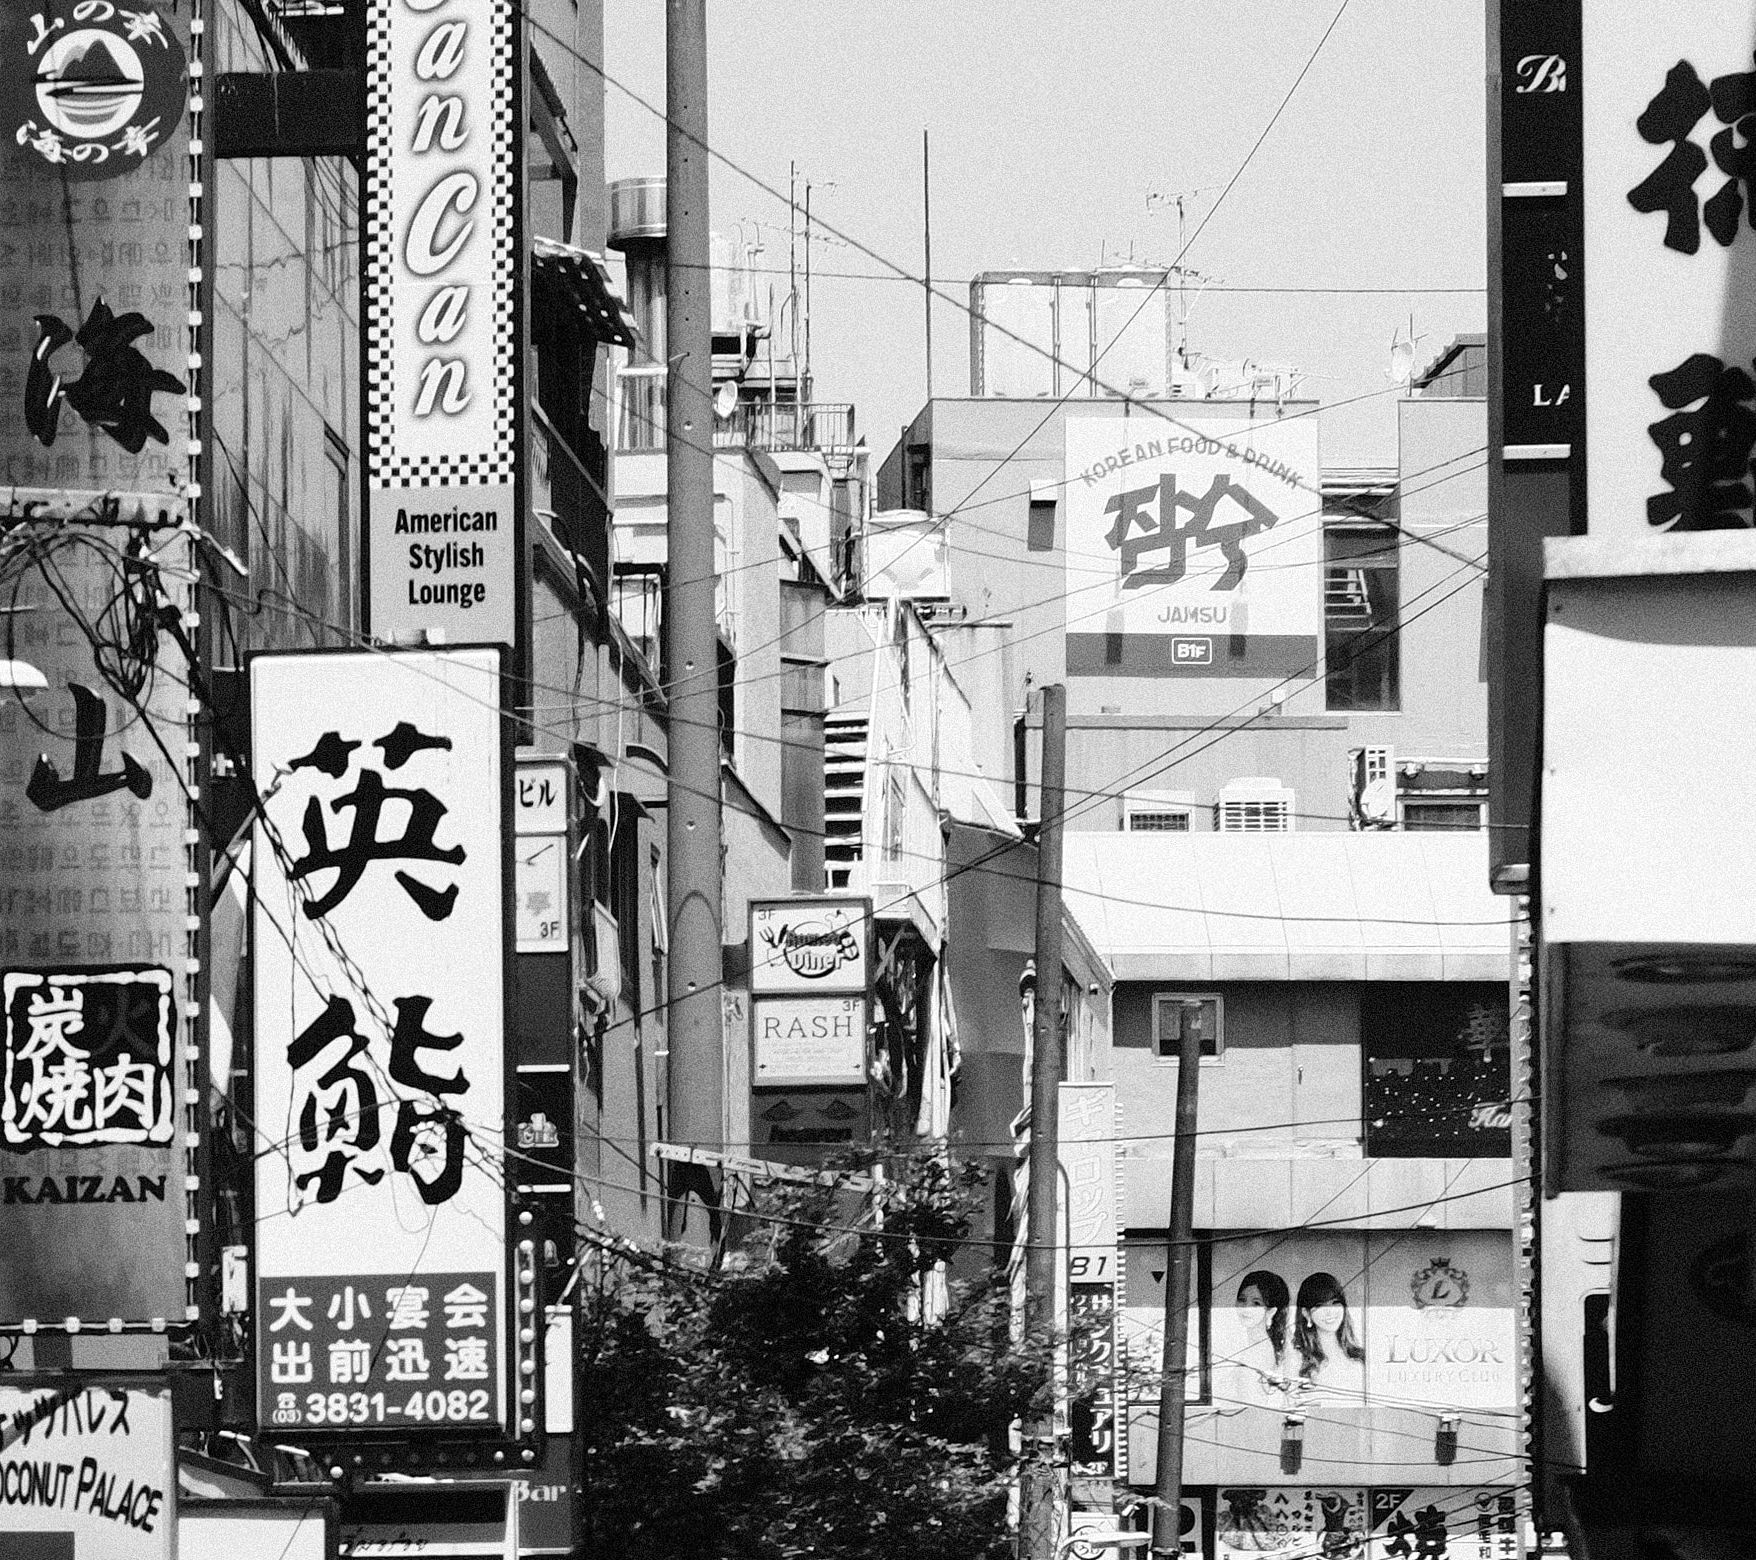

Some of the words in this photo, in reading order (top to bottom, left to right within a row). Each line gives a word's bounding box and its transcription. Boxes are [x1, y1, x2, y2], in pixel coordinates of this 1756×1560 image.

[1080, 441, 1164, 488] KOREAN
[1167, 436, 1223, 455] FOOD
[1244, 448, 1304, 490] DRINK
[394, 507, 499, 536] American
[407, 541, 486, 576] Stylish
[407, 578, 487, 612] Lounge
[1157, 605, 1227, 624] JAMSU
[519, 778, 559, 808] ビル
[540, 921, 560, 939] 3F
[843, 1000, 860, 1012] 3F
[764, 1015, 854, 1039] RASH
[2, 1175, 168, 1205] KAIZAN
[1070, 1256, 1107, 1276] B1
[269, 1282, 488, 1332] 大小宴会
[271, 1336, 489, 1384] 出前迅速
[1385, 1334, 1504, 1364] LUXOR
[305, 1389, 489, 1424] 3831-4082
[74, 1455, 163, 1534] PALACE
[1376, 1493, 1401, 1510] 2F
